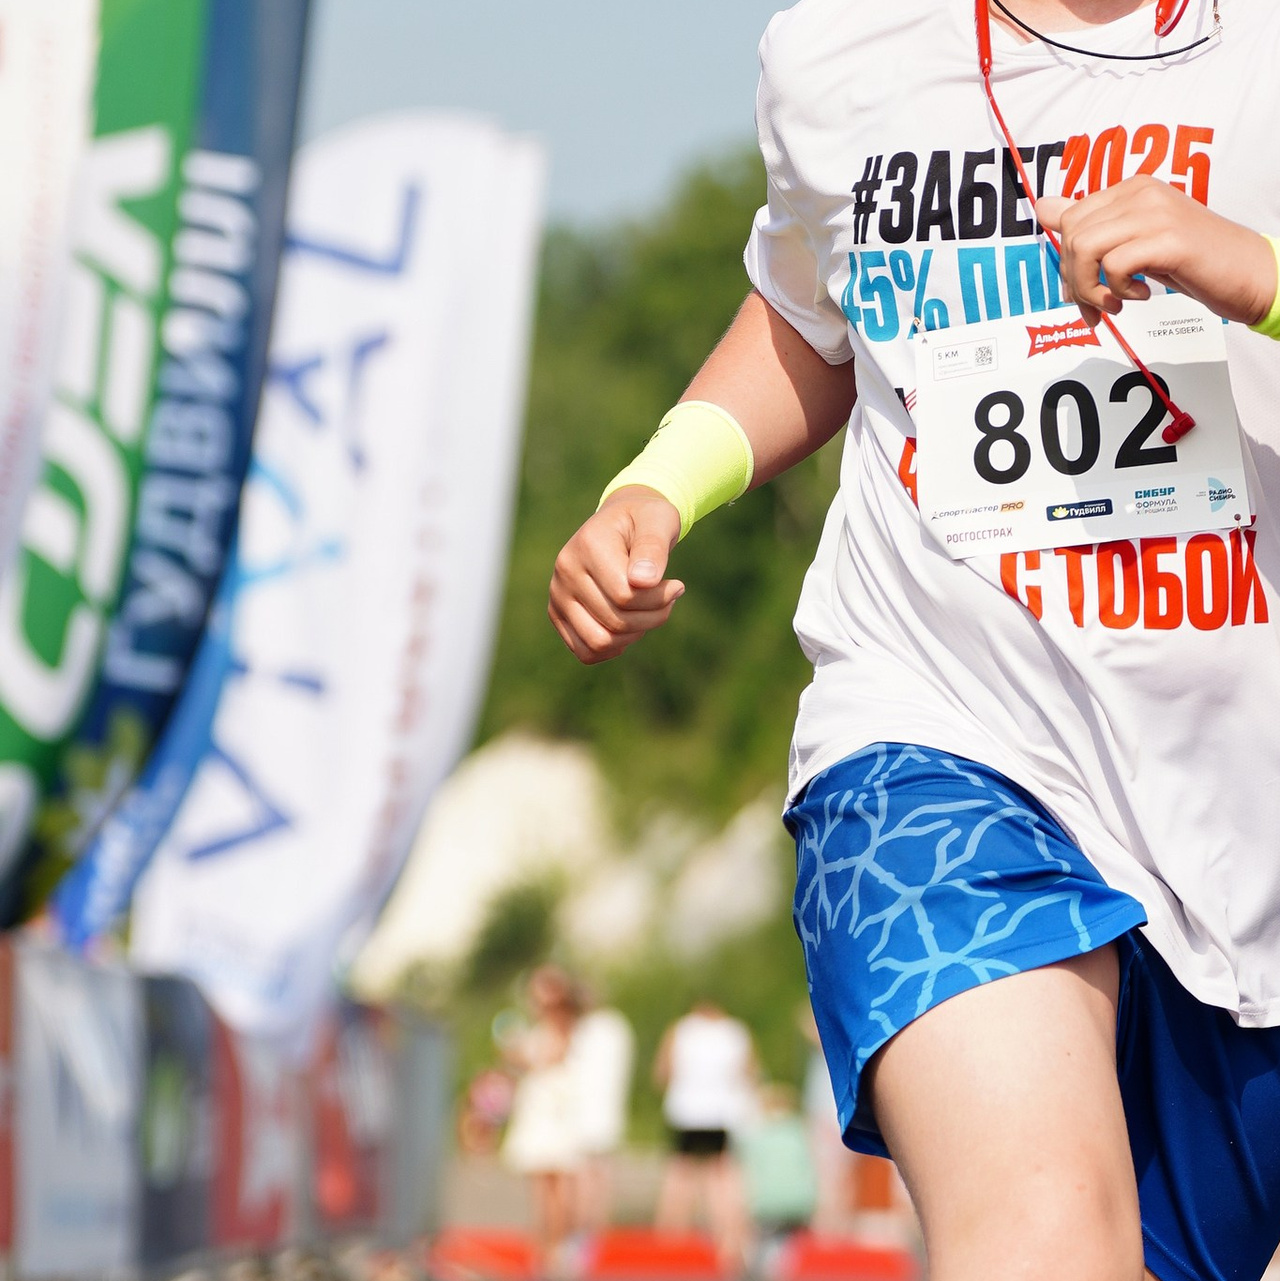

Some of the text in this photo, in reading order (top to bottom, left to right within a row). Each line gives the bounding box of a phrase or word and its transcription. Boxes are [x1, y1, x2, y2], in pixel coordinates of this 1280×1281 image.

[1035, 327, 1092, 345] Альфа Банк
[1147, 325, 1204, 337] TERRA SIBERIA
[973, 370, 1178, 484] 802
[1134, 486, 1175, 499] СИБУР
[1208, 487, 1232, 496] РАДИО
[1000, 501, 1024, 512] PRO
[1136, 498, 1177, 509] ФОРМУЛА
[1136, 507, 1165, 515] ХРОШИХ
[946, 526, 1013, 544] РОСГОССТРАХ
